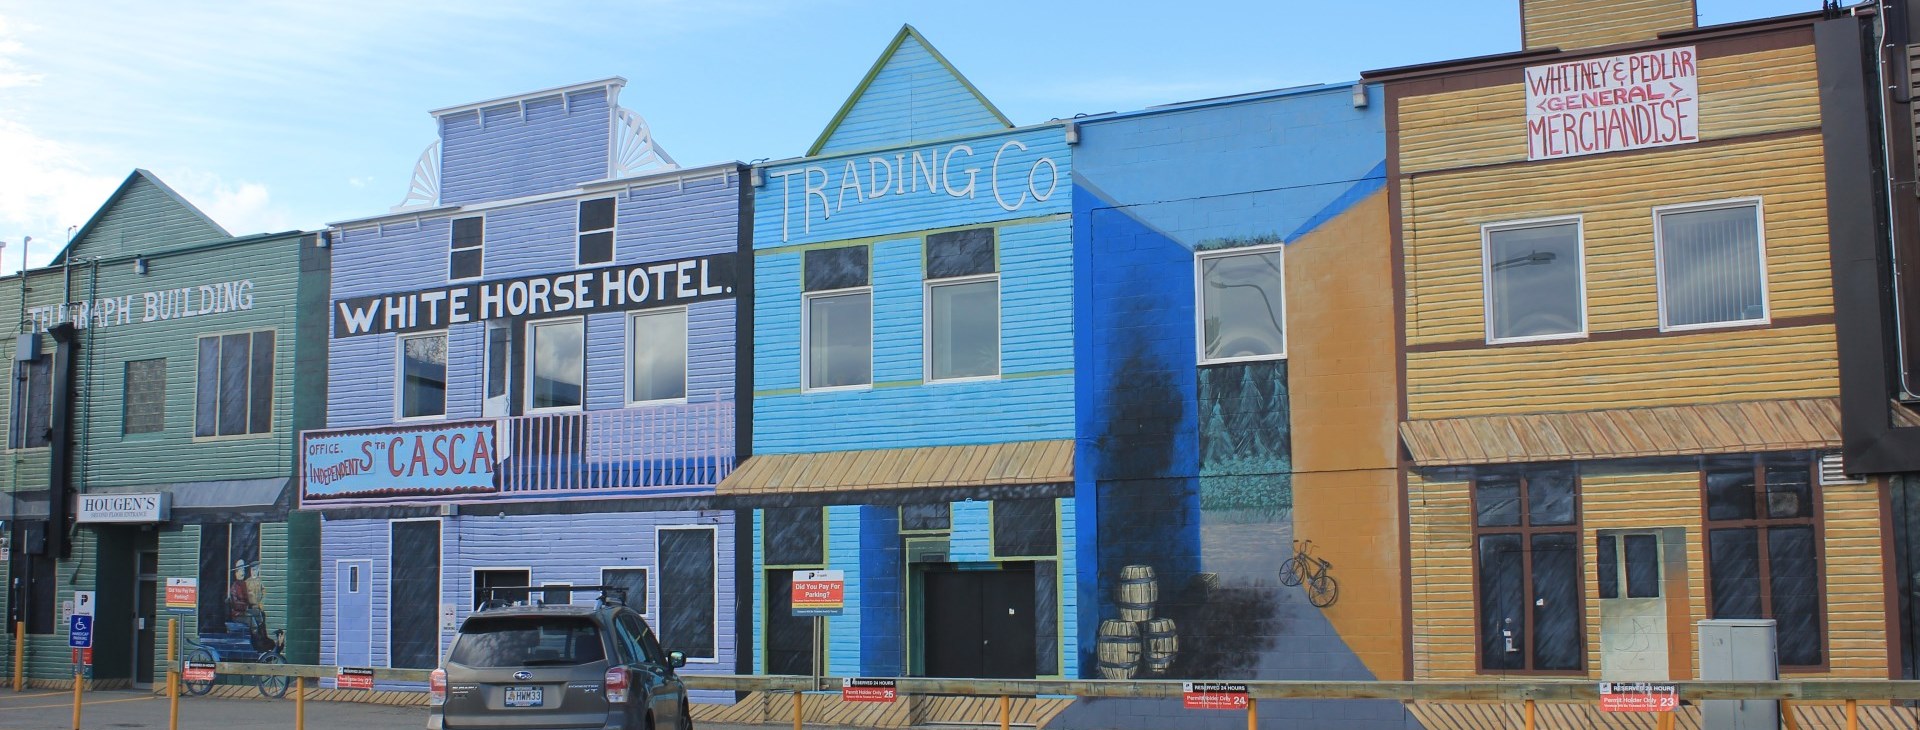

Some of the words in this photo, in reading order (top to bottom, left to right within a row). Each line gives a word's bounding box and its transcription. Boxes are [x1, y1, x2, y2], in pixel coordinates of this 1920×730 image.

[1527, 60, 1610, 97] WHITNEY
[1613, 57, 1628, 86] &
[1629, 51, 1695, 85] PEDLAR
[1528, 97, 1697, 159] MERCHANDISE
[770, 145, 980, 243] TRADING
[142, 280, 254, 321] BUILDING
[339, 288, 470, 334] WHITE
[480, 273, 594, 320] HORSE
[601, 259, 734, 306] HOTEL.
[309, 444, 343, 456] OFFICE.
[388, 431, 493, 477] CASCA
[84, 497, 156, 511] HOUGEN'S
[805, 591, 831, 599] Parking?
[516, 691, 541, 701] HWM33
[1233, 696, 1246, 705] 24
[1660, 697, 1674, 707] 23
